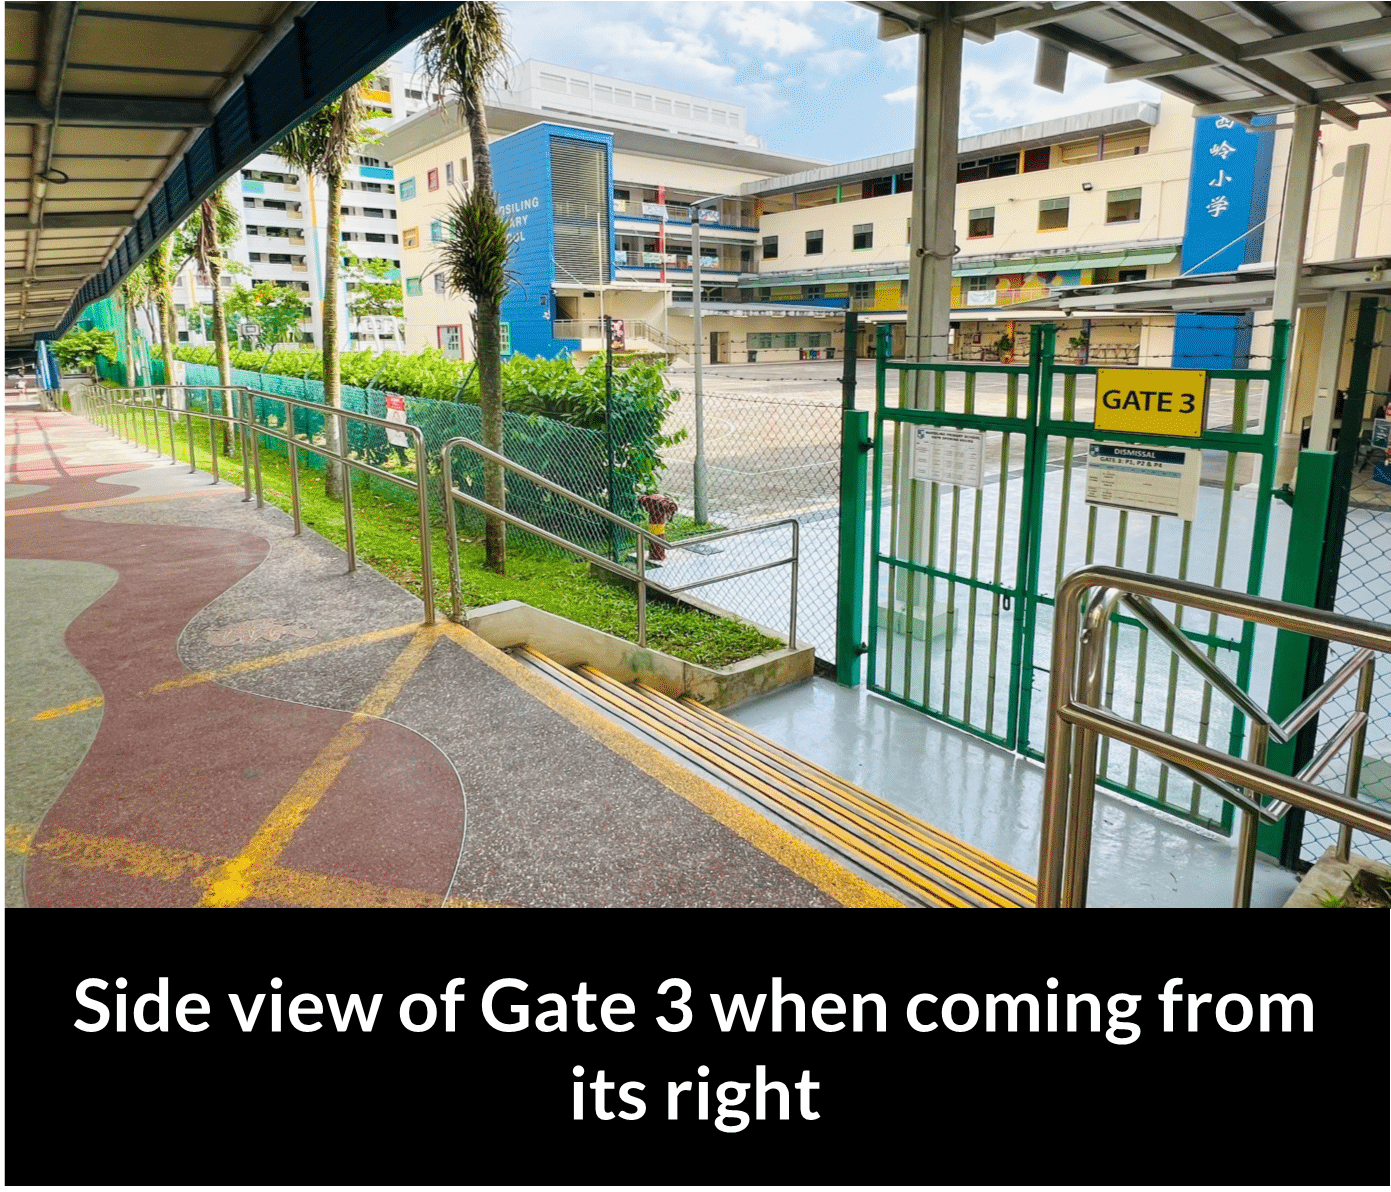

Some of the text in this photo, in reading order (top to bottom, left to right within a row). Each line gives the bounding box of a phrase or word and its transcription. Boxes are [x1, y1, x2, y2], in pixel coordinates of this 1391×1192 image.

[1102, 389, 1195, 414] GATE 3
[1114, 448, 1156, 459] DISMISSAL
